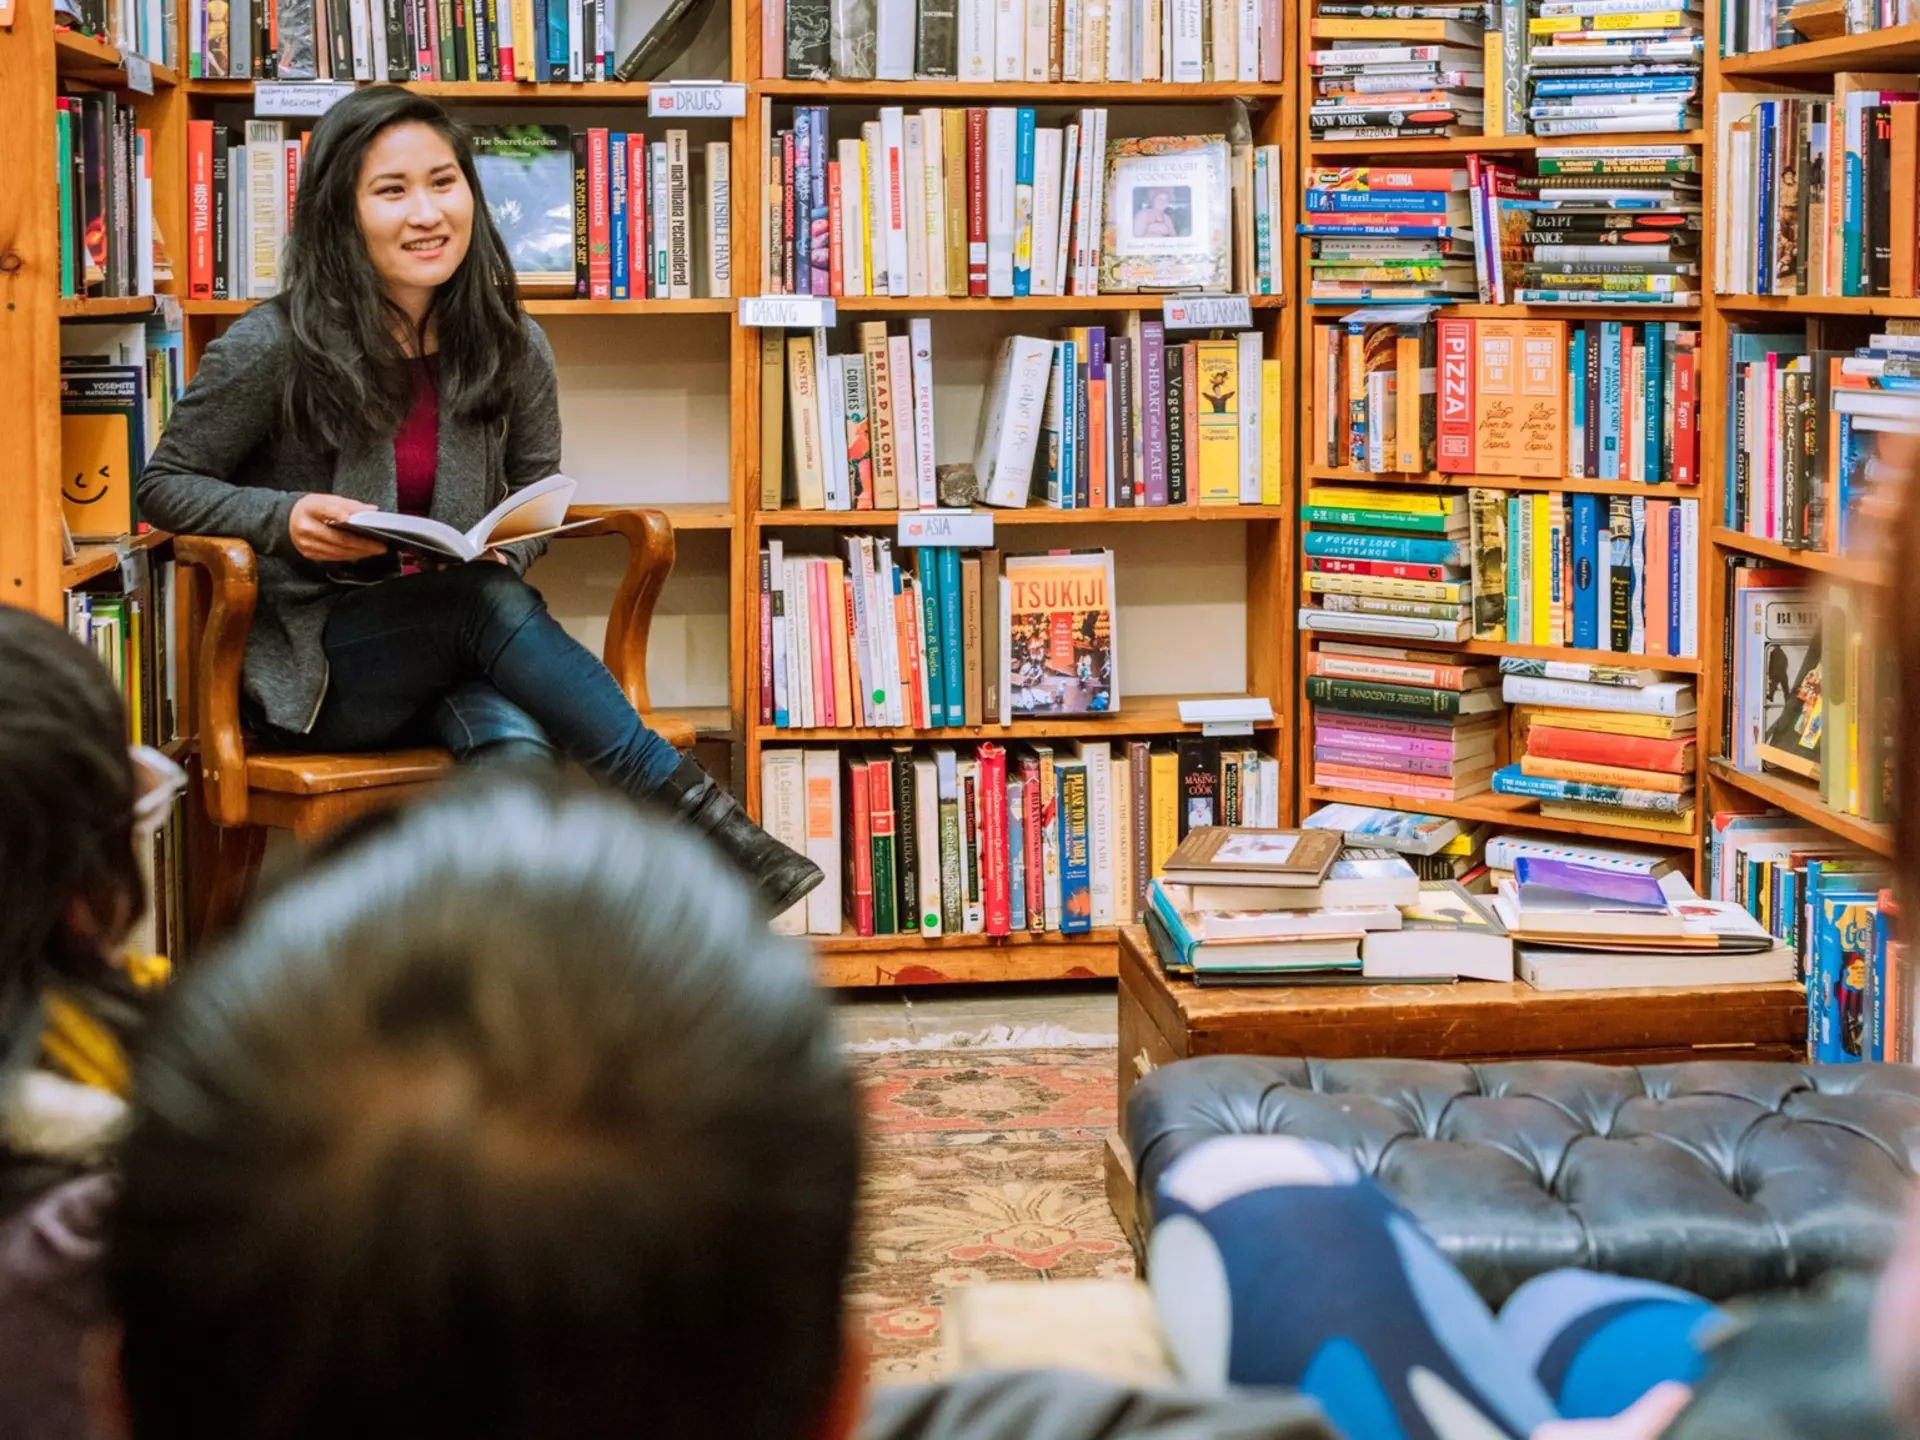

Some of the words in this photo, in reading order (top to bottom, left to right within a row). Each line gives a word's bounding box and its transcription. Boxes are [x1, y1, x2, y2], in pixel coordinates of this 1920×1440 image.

[676, 90, 722, 111] DRUGS
[1312, 115, 1337, 127] NEW
[1339, 114, 1367, 126] YORK
[1353, 127, 1393, 138] ARIZONA
[473, 137, 492, 146] The
[492, 137, 522, 146] Secret
[522, 137, 557, 146] Garden
[253, 151, 276, 171] AND
[288, 152, 297, 170] THE
[633, 148, 642, 186] Respiratory
[785, 134, 794, 183] CASSEROLE
[1164, 162, 1197, 172] TRASH
[254, 174, 276, 193] THE
[288, 173, 297, 192] RED
[593, 138, 605, 226] cannabinomics
[1136, 172, 1188, 181] COOKING
[1386, 173, 1413, 186] CHINA
[576, 182, 586, 206] SEVEN
[634, 189, 643, 217] Therapy
[671, 164, 687, 217] marihuana
[1340, 194, 1369, 203] Brazil
[194, 184, 208, 234] HOSPITAL
[254, 197, 276, 223] BAND
[576, 207, 586, 235] SISTERS
[713, 180, 729, 241] INVISIBLE
[785, 184, 794, 238] COOKBOOK
[1536, 215, 1573, 227] EGYPT
[1365, 226, 1400, 234] THAILAND
[1524, 231, 1564, 244] VENICE
[254, 226, 276, 263] PLAYED
[577, 247, 587, 265] SLEEP
[634, 219, 645, 272] Pharmacology
[672, 220, 688, 286] reconsidered
[254, 266, 275, 279] ON
[714, 243, 729, 281] HAND
[1575, 264, 1621, 274] SASTUN
[1149, 352, 1158, 367] The
[1612, 340, 1620, 366] FORD
[92, 382, 136, 390] YOSEMITE
[797, 350, 810, 398] PASTRY
[1445, 338, 1465, 415] PIZZA
[1604, 367, 1613, 405] provence
[1612, 368, 1620, 404] MADOX
[846, 368, 859, 411] COOKIES
[1077, 378, 1086, 411] Ayurveda
[1149, 368, 1160, 414] HEART
[1647, 379, 1656, 403] WEST
[875, 351, 888, 410] BREAD
[882, 419, 893, 478] ALONE
[920, 386, 930, 437] PERFECT
[1151, 416, 1160, 425] of
[1612, 406, 1620, 432] FORD
[1677, 401, 1691, 429] Egypt
[1737, 391, 1745, 452] CHINESE
[1078, 412, 1086, 441] Cooking
[1151, 425, 1160, 439] the
[1166, 376, 1183, 488] Vegetarianism
[1647, 414, 1656, 443] NIGHT
[921, 443, 931, 483] FINISH
[1151, 441, 1162, 481] PLATE
[1737, 454, 1745, 494] GOLD
[1786, 414, 1797, 530] CALIFORNIA
[1521, 499, 1532, 510] AN
[1672, 509, 1680, 525] Eric
[924, 518, 953, 536] ASIA
[1521, 511, 1532, 532] AREA
[1315, 535, 1322, 543] A
[1324, 536, 1366, 547] VOYAGE
[1369, 539, 1398, 548] LONG
[1522, 532, 1532, 542] OF
[1671, 526, 1680, 551] Newby
[1339, 547, 1389, 557] STRANGE
[1522, 543, 1532, 581] DARKNESS
[1014, 579, 1103, 609] TSUKIJI
[926, 597, 938, 632] Curries
[947, 591, 958, 637] Tradewinds
[927, 636, 937, 644] &
[928, 646, 939, 678] Bugles
[1333, 687, 1349, 697] THE
[1350, 689, 1396, 702] INNOCENTS
[1397, 693, 1432, 706] ABROAD
[781, 765, 792, 777] La
[900, 761, 909, 775] LA
[1095, 753, 1105, 774] THE
[1065, 773, 1086, 806] PLEASE
[1185, 775, 1217, 785] MAKING
[1189, 785, 1213, 796] COOK
[781, 780, 792, 817] Cuisine
[901, 777, 912, 821] CUCINA
[1031, 792, 1041, 824] BALKAN
[1096, 776, 1106, 835] SPLENDID
[1071, 808, 1085, 820] TO
[1118, 804, 1127, 820] THE
[782, 821, 794, 834] de
[903, 823, 912, 833] DI
[945, 816, 956, 855] Essential
[1071, 820, 1086, 840] THE
[903, 833, 913, 864] LIDIA
[1033, 825, 1041, 869] COOKBOOK
[1068, 840, 1087, 867] TABLE
[1098, 839, 1107, 871] TABLE
[1119, 824, 1128, 860] SHAKER
